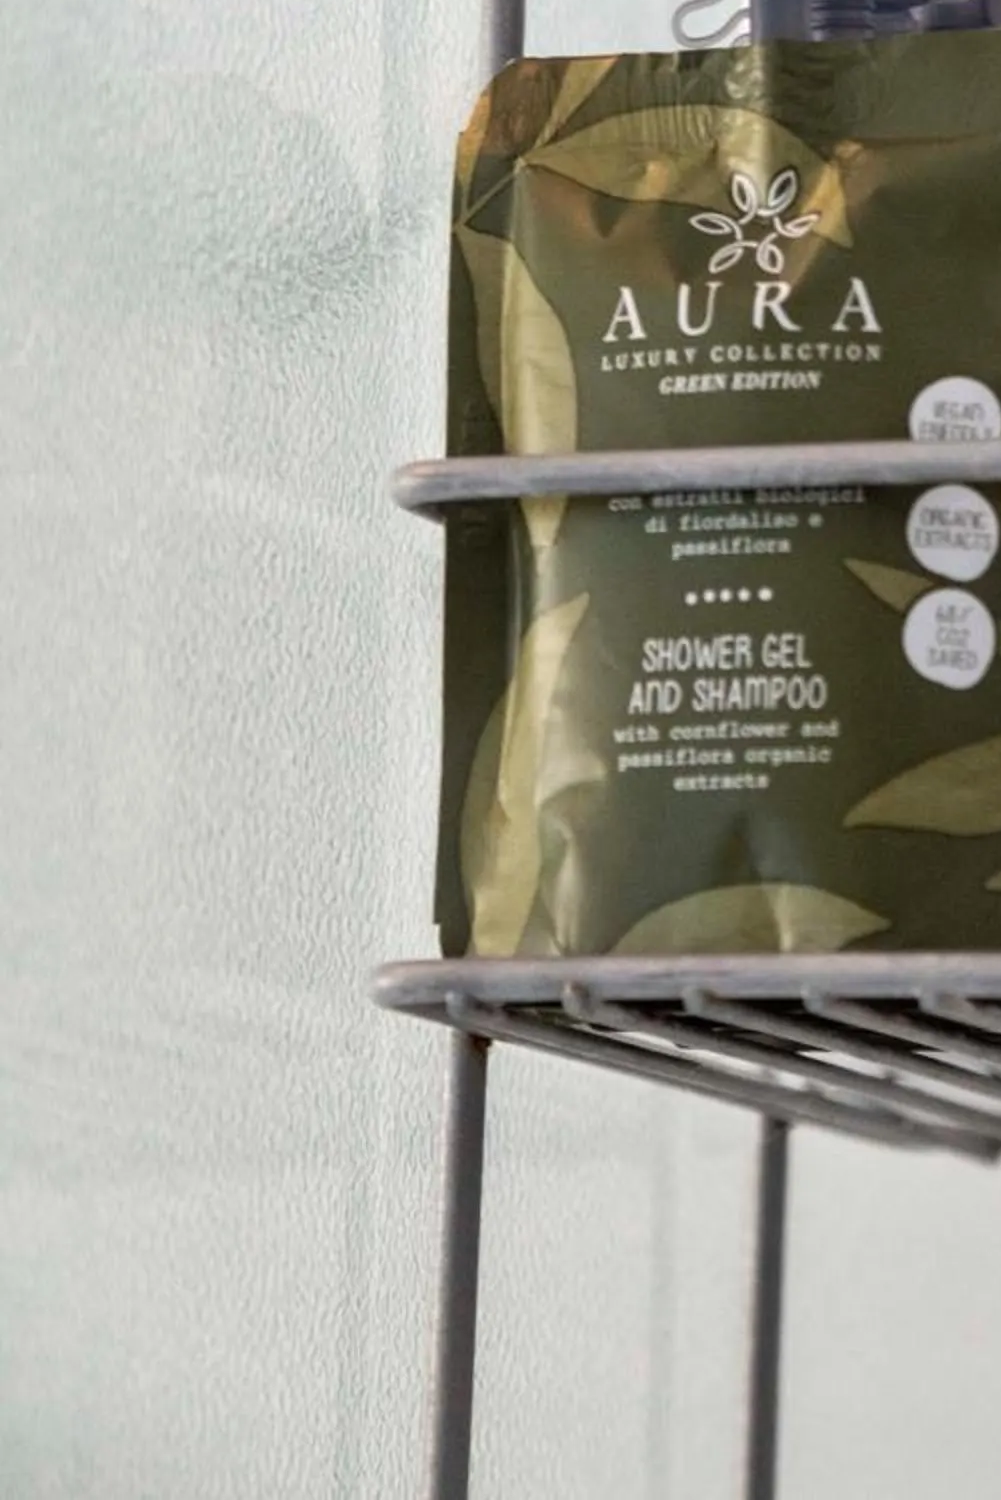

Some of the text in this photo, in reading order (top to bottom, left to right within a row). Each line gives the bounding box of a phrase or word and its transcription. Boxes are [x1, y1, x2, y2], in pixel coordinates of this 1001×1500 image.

[602, 277, 882, 342] AURA
[601, 343, 882, 371] LUXURY COLLECTION
[658, 369, 822, 395] GREEN EDITION
[608, 496, 642, 512] con
[645, 512, 824, 533] di fiordaliso e
[671, 536, 791, 560] passiflora
[642, 632, 813, 673] SHOWER GEL
[628, 673, 827, 715] AND SHAMPOO
[613, 718, 840, 743] with cornflower and
[618, 744, 832, 772] passiflora organic
[673, 773, 769, 791] extracts
